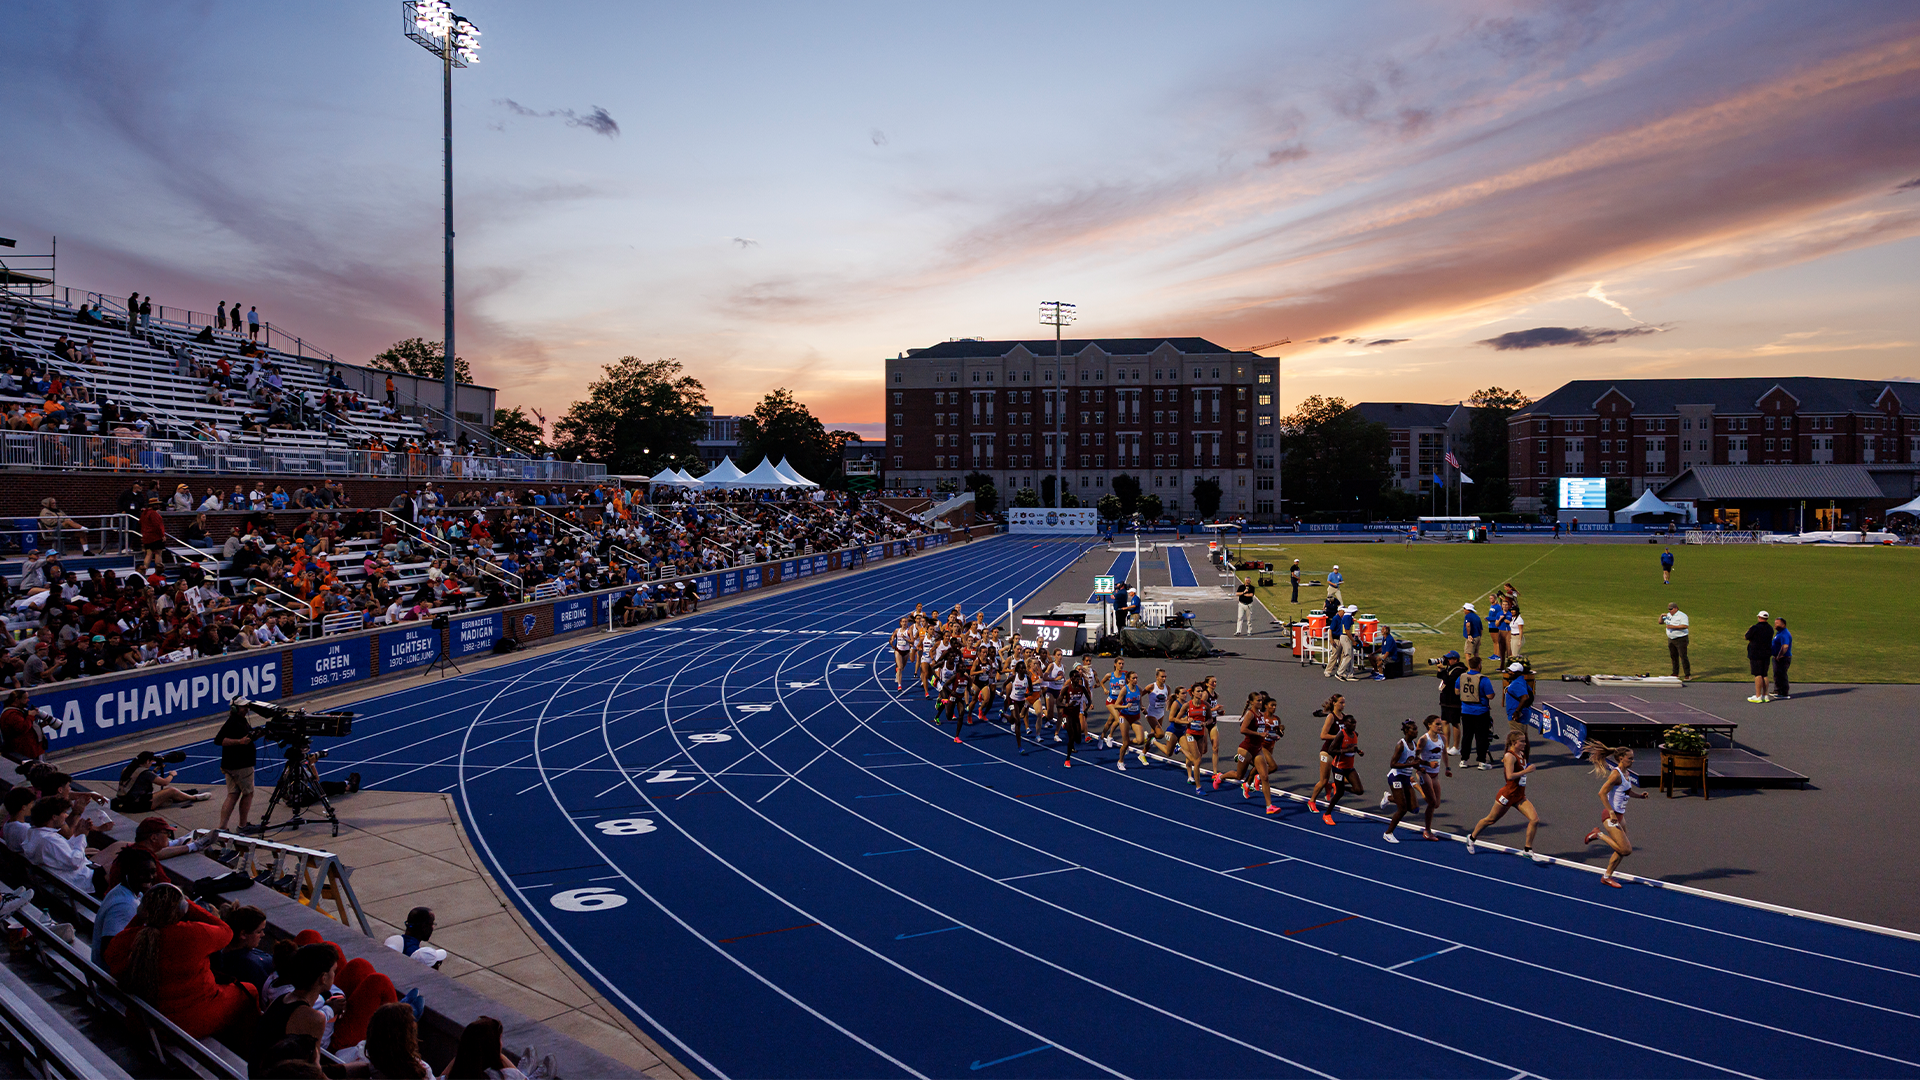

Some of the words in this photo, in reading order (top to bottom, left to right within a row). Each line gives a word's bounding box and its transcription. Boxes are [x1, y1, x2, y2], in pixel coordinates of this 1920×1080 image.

[1098, 578, 1111, 593] 12
[561, 608, 587, 622] BREIDING
[461, 617, 492, 630] BERNADETTE
[406, 631, 418, 640] BILL
[460, 626, 493, 642] MADIGAN
[1037, 626, 1060, 641] 39.9
[328, 645, 340, 655] JIM
[391, 637, 432, 657] LIGHTSEY
[315, 654, 350, 672] GREEN
[420, 650, 435, 661] JUMP
[95, 662, 276, 729] CHAMPIONS
[1463, 683, 1475, 695] 60
[594, 818, 658, 836] 8
